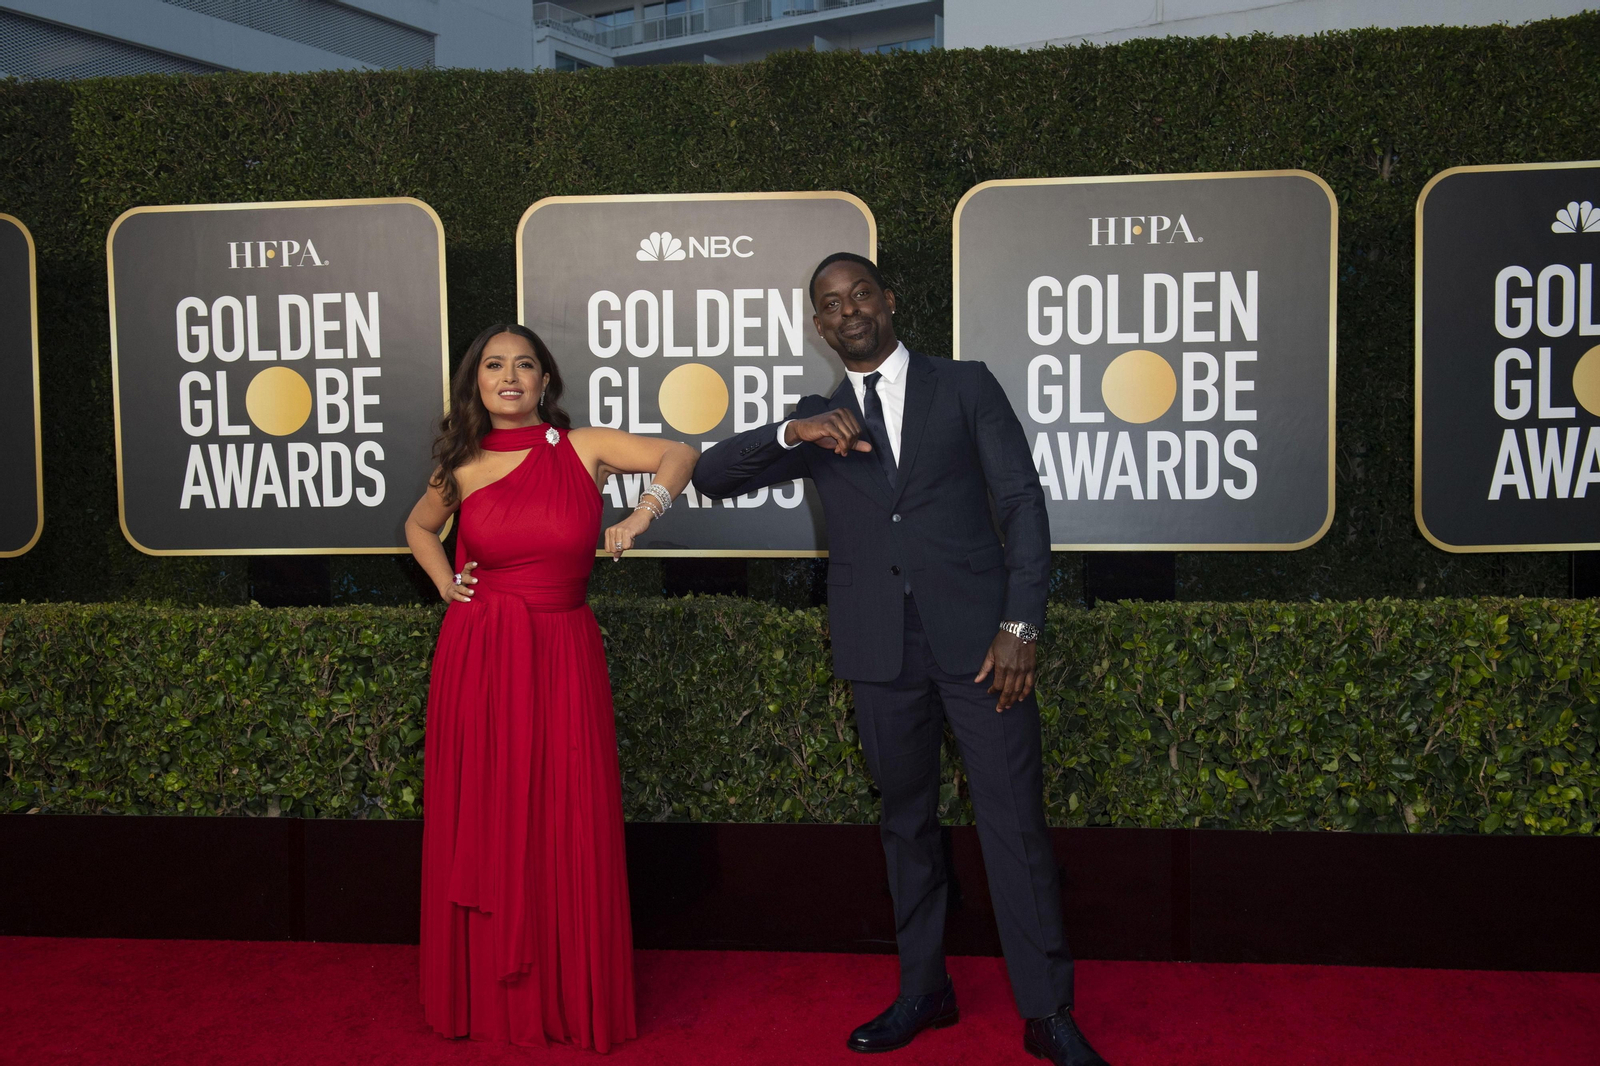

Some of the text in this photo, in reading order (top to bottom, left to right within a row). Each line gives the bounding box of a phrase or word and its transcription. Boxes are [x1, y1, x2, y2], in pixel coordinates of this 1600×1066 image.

[688, 235, 755, 259] NBC
[176, 291, 381, 363] GOLDEN
[587, 288, 804, 359] GOLDEN
[1027, 270, 1259, 346] GOLDEN
[179, 366, 384, 437] GLOBE
[1027, 349, 1258, 424] GLOBE
[180, 440, 386, 509] AWARDS
[1032, 429, 1258, 501] AWARDS
